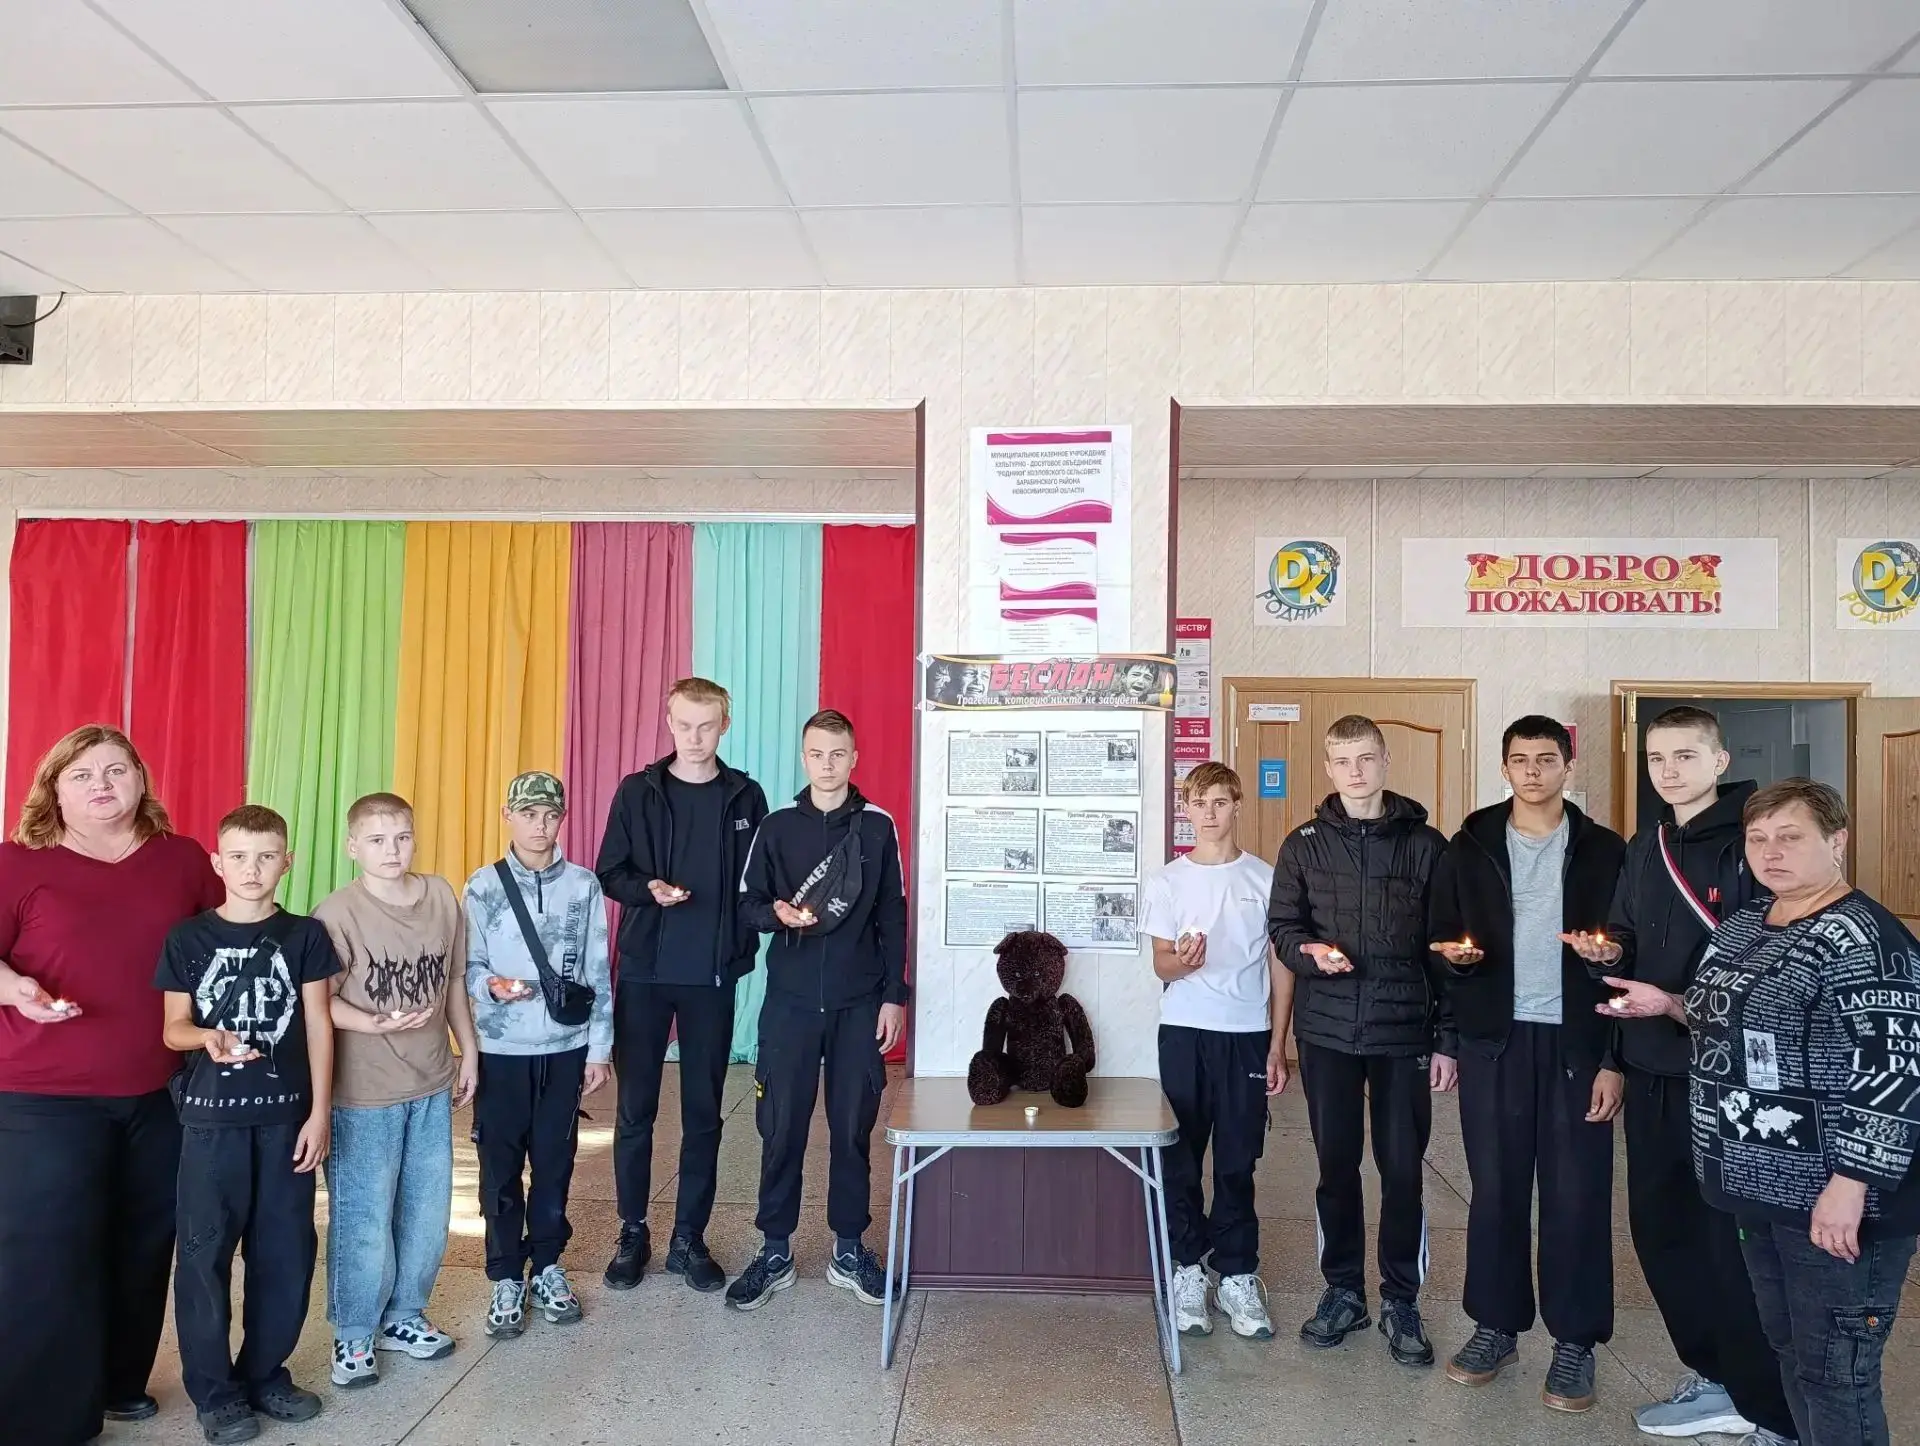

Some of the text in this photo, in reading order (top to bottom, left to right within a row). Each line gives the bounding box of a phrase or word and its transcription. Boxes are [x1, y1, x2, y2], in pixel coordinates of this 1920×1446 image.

[1507, 554, 1681, 586] ДОБРО
[1466, 590, 1722, 614] ПОЖАЛОВАТЬ!
[988, 662, 1115, 691] БЕСЛАН
[1004, 695, 1049, 706] которую
[1051, 694, 1082, 704] никто
[1085, 695, 1095, 704] не
[1300, 826, 1316, 836] HH
[563, 954, 577, 983] LAT
